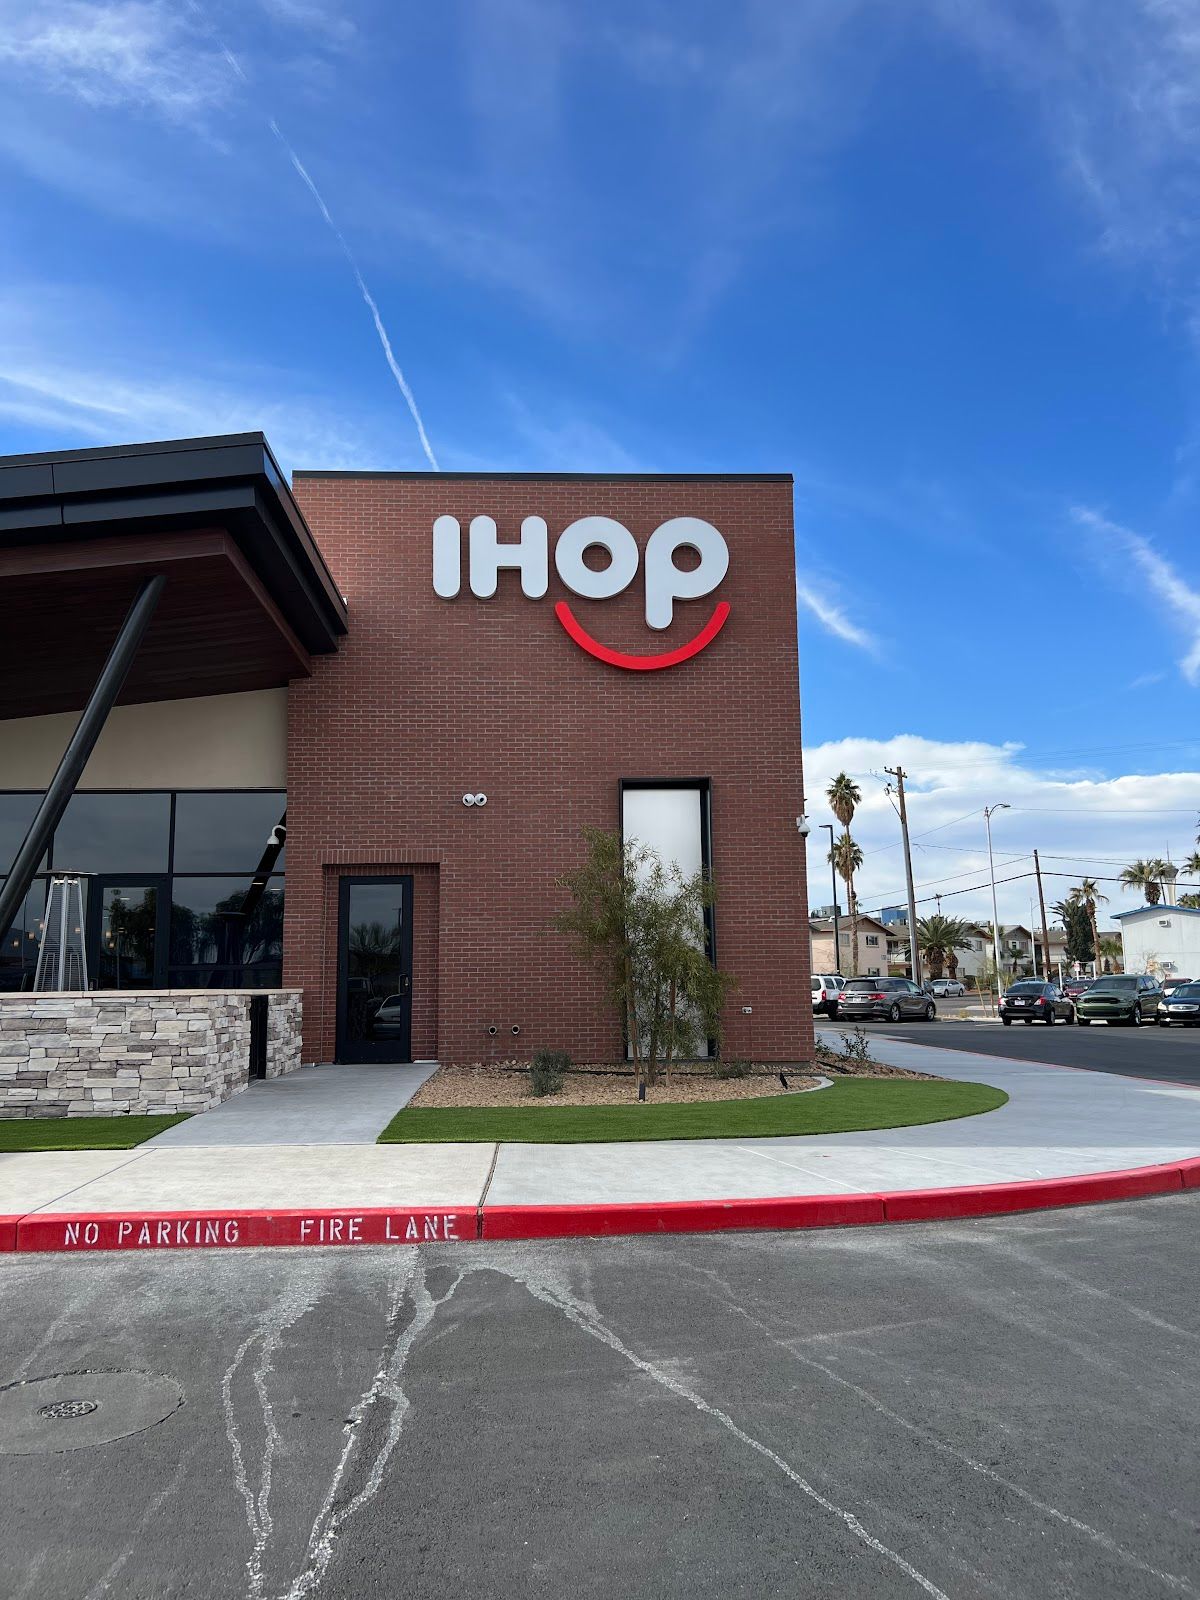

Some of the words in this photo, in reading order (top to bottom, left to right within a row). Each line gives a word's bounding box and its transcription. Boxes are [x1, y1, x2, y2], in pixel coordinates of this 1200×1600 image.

[64, 1222, 99, 1245] NO
[118, 1220, 239, 1244] PARKING
[300, 1217, 363, 1241] FIRE
[385, 1214, 459, 1240] LANE
